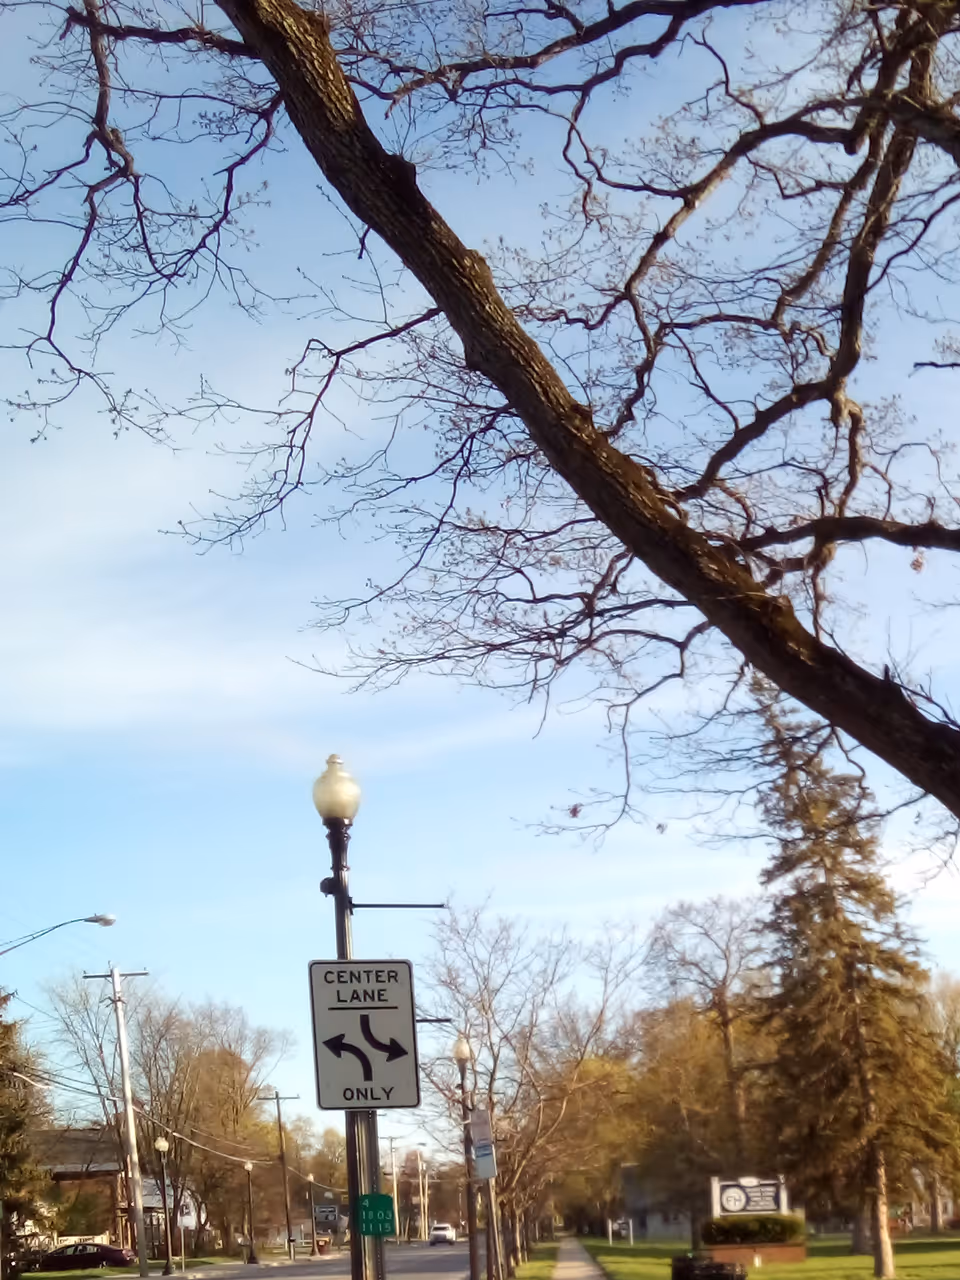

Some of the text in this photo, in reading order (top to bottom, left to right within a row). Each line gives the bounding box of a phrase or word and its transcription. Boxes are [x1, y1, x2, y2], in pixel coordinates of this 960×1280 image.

[323, 970, 399, 984] CENTER
[336, 989, 389, 1003] LANE
[343, 1086, 394, 1101] ONLY
